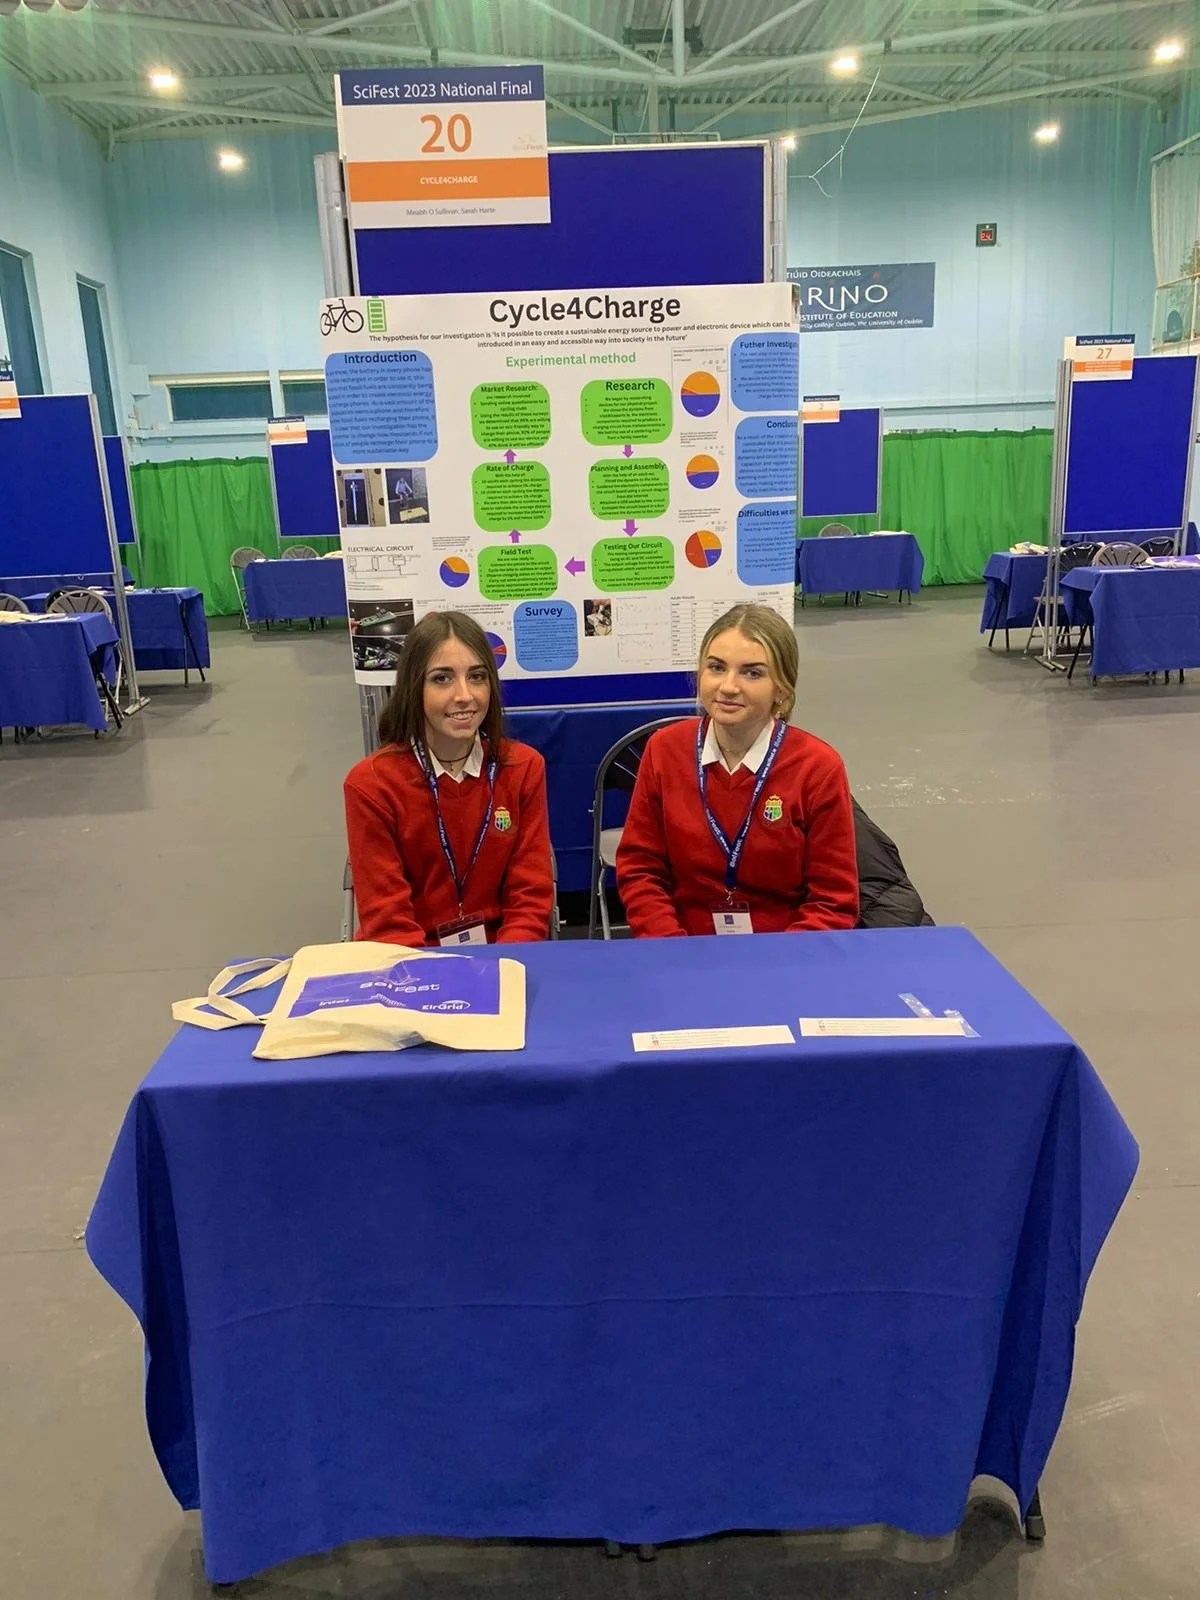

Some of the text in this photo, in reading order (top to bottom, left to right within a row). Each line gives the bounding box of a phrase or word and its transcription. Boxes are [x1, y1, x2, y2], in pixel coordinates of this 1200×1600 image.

[353, 80, 532, 99] SciFest 2023 National Final
[420, 114, 472, 153] 20
[420, 176, 478, 184] CYCLE4CHARGE
[810, 270, 861, 278] OIDEACHAIS
[800, 284, 887, 312] RINO
[490, 295, 681, 328] Cycle4Charge
[345, 352, 416, 364] Introduction
[1097, 348, 1112, 359] 27
[506, 352, 636, 368] Experimental method
[605, 380, 655, 390] Research
[738, 509, 779, 517] Difficulties
[525, 607, 563, 617] Survey
